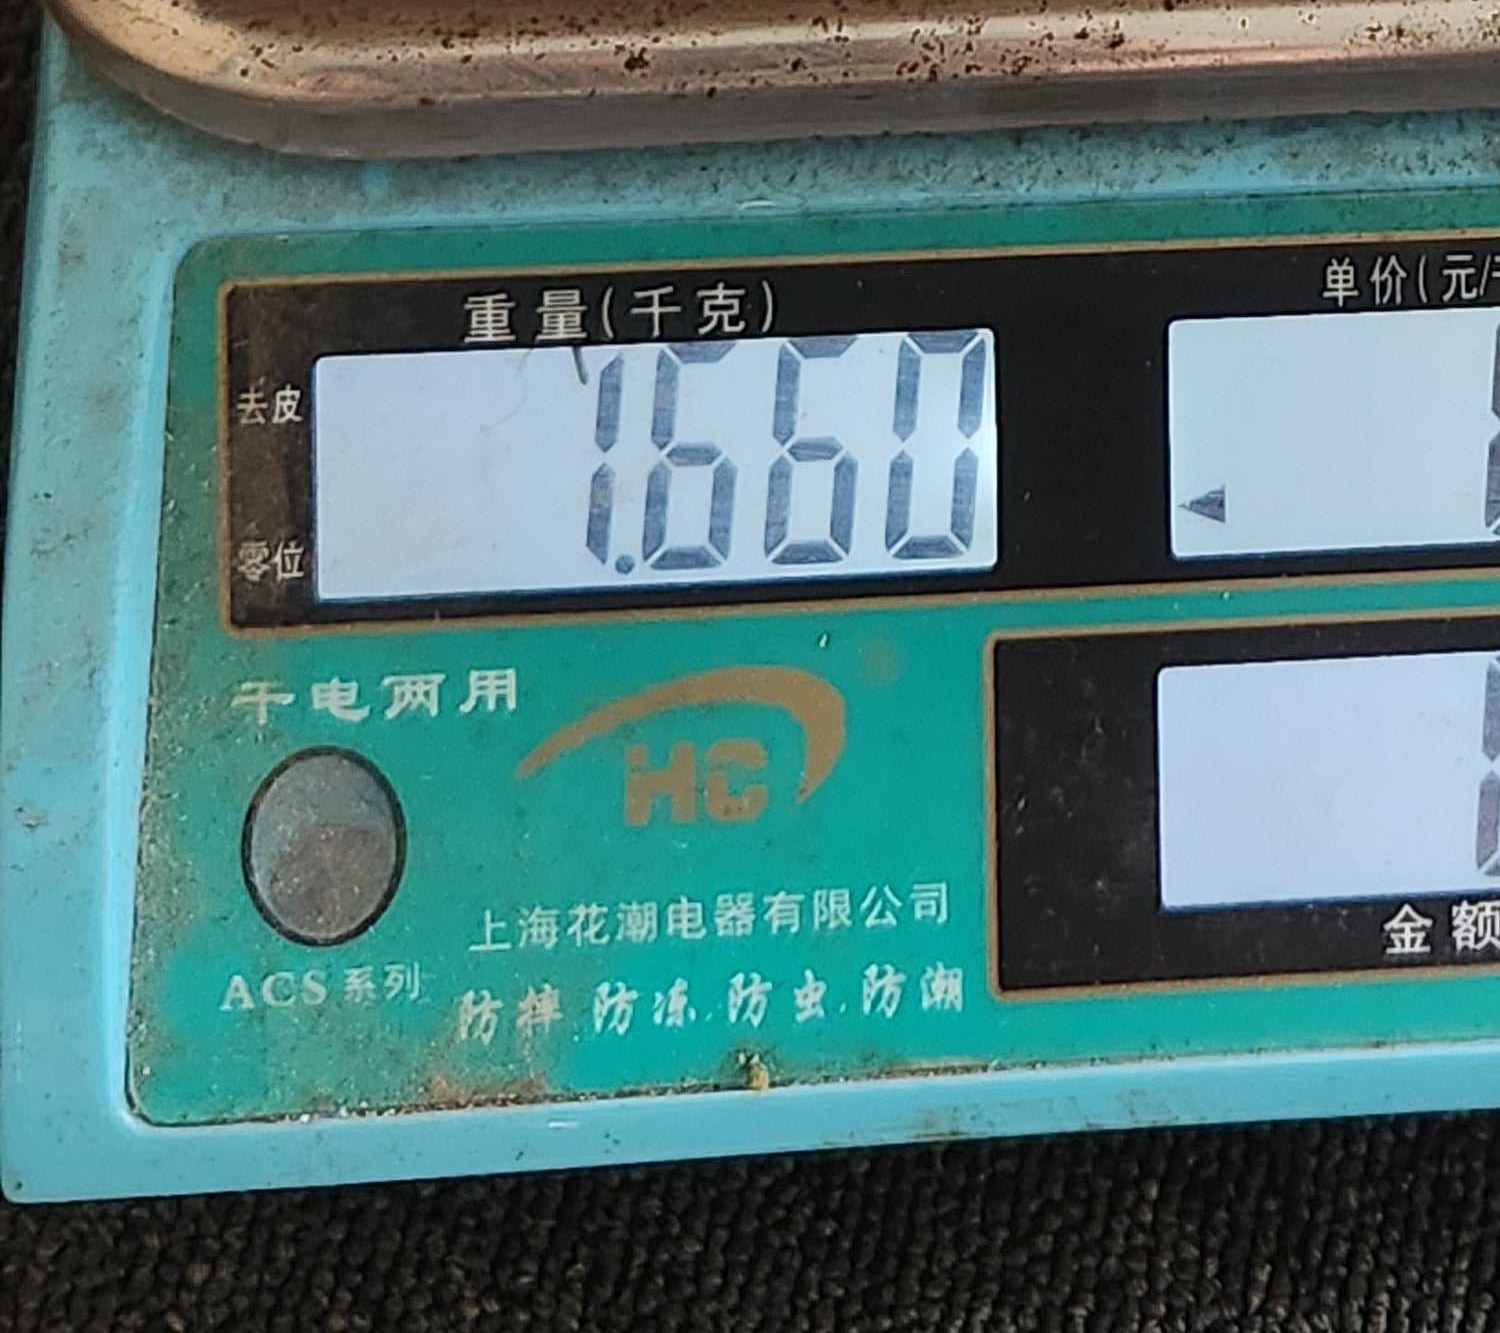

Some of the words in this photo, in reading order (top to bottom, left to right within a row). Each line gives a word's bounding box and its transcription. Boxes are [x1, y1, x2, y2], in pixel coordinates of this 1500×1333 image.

[464, 280, 777, 344] 重量(千克)
[236, 383, 303, 426] 去皮
[586, 332, 986, 574] 1.660
[237, 540, 304, 581] 零位
[468, 882, 948, 953] 上海花潮电器有限公司
